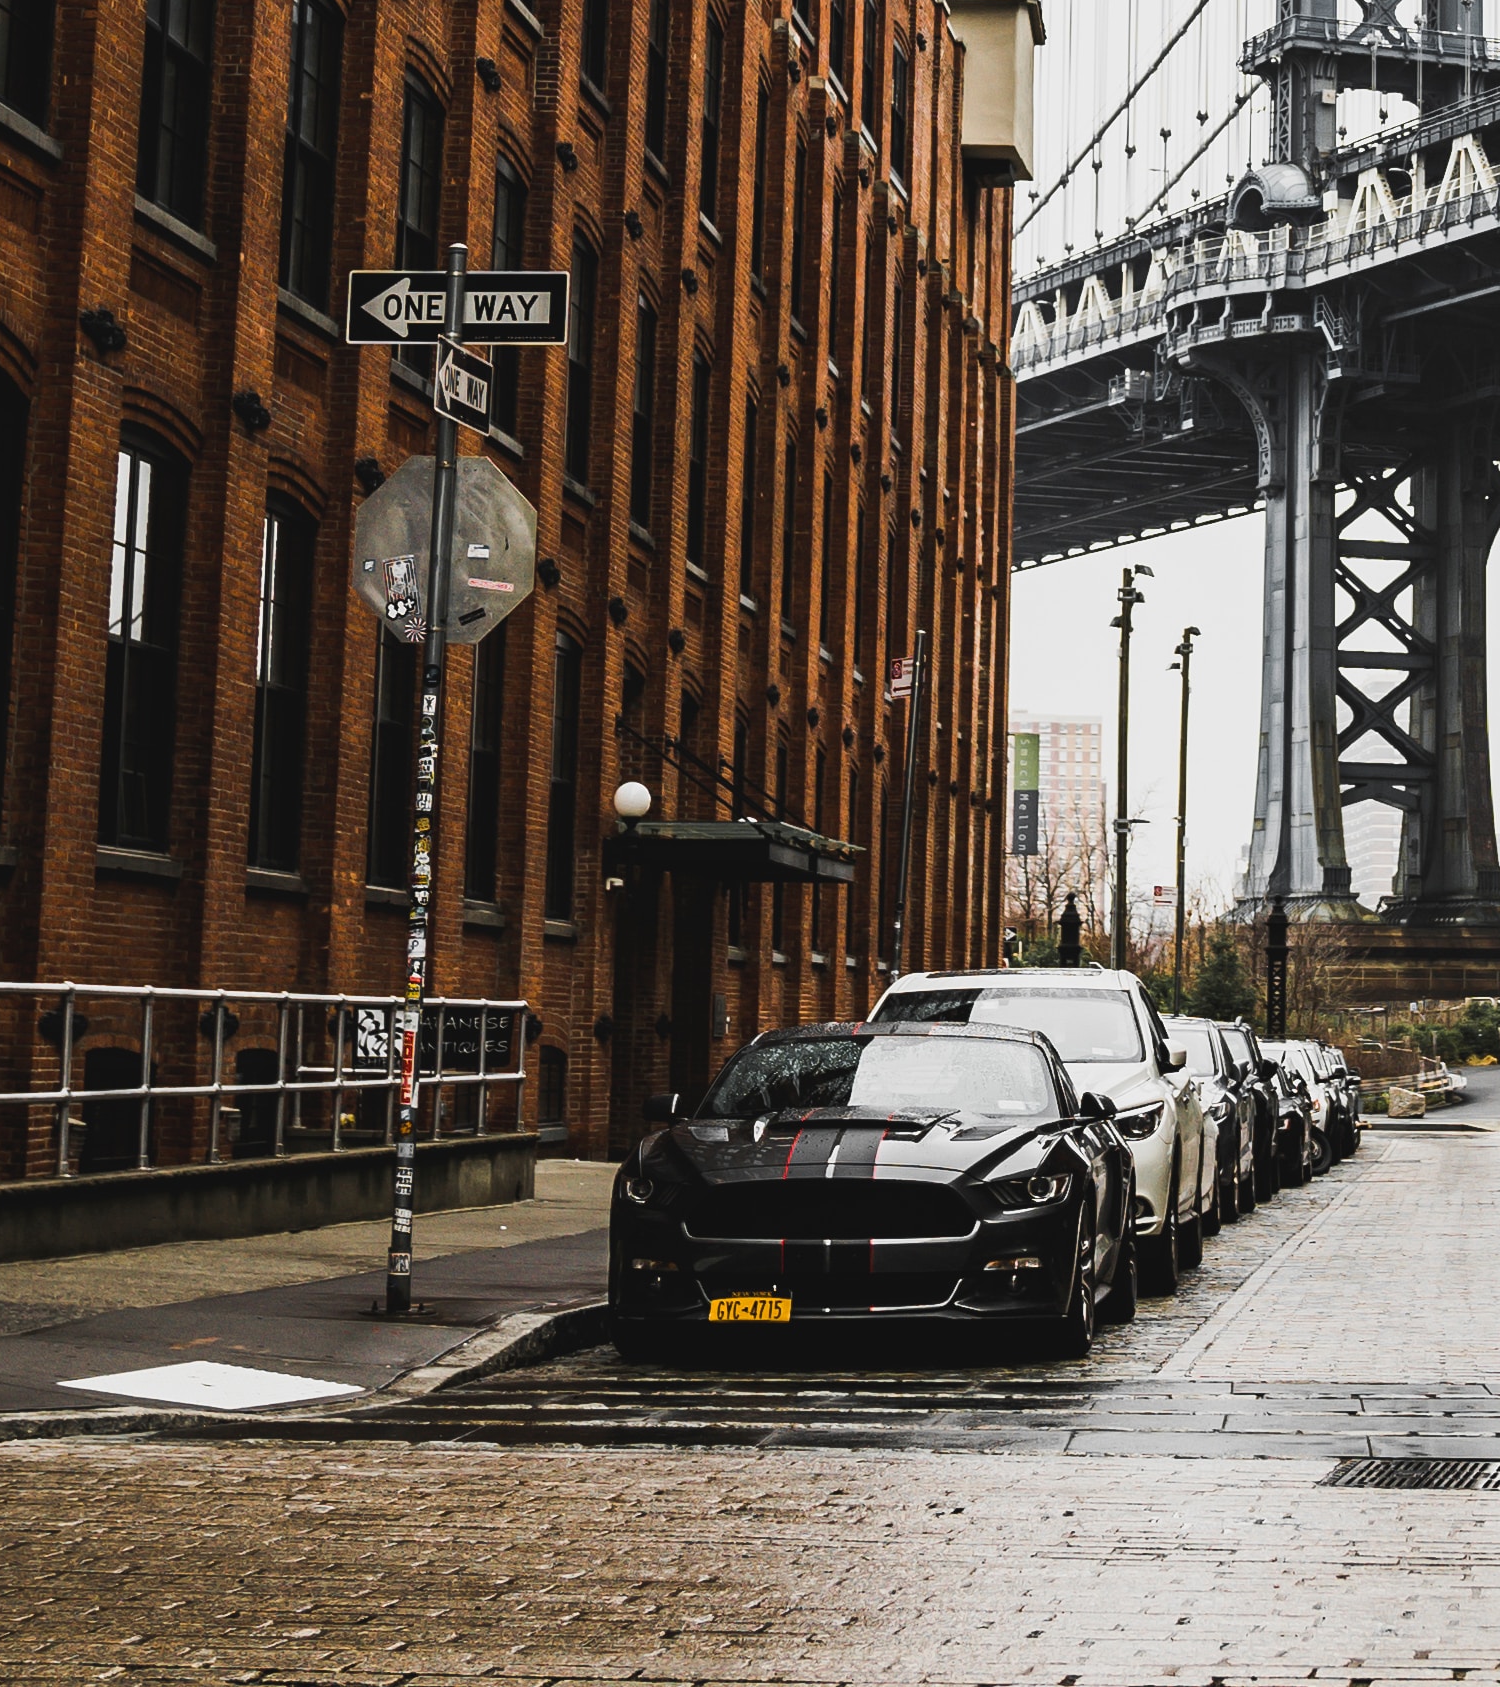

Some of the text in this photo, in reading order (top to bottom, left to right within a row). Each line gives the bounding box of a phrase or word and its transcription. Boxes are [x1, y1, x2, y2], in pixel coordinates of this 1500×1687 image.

[383, 294, 539, 321] ONE WAY
[444, 364, 485, 409] ONE WAY
[1018, 738, 1030, 851] Smack Mellon
[717, 1300, 783, 1320] GYC 4715
